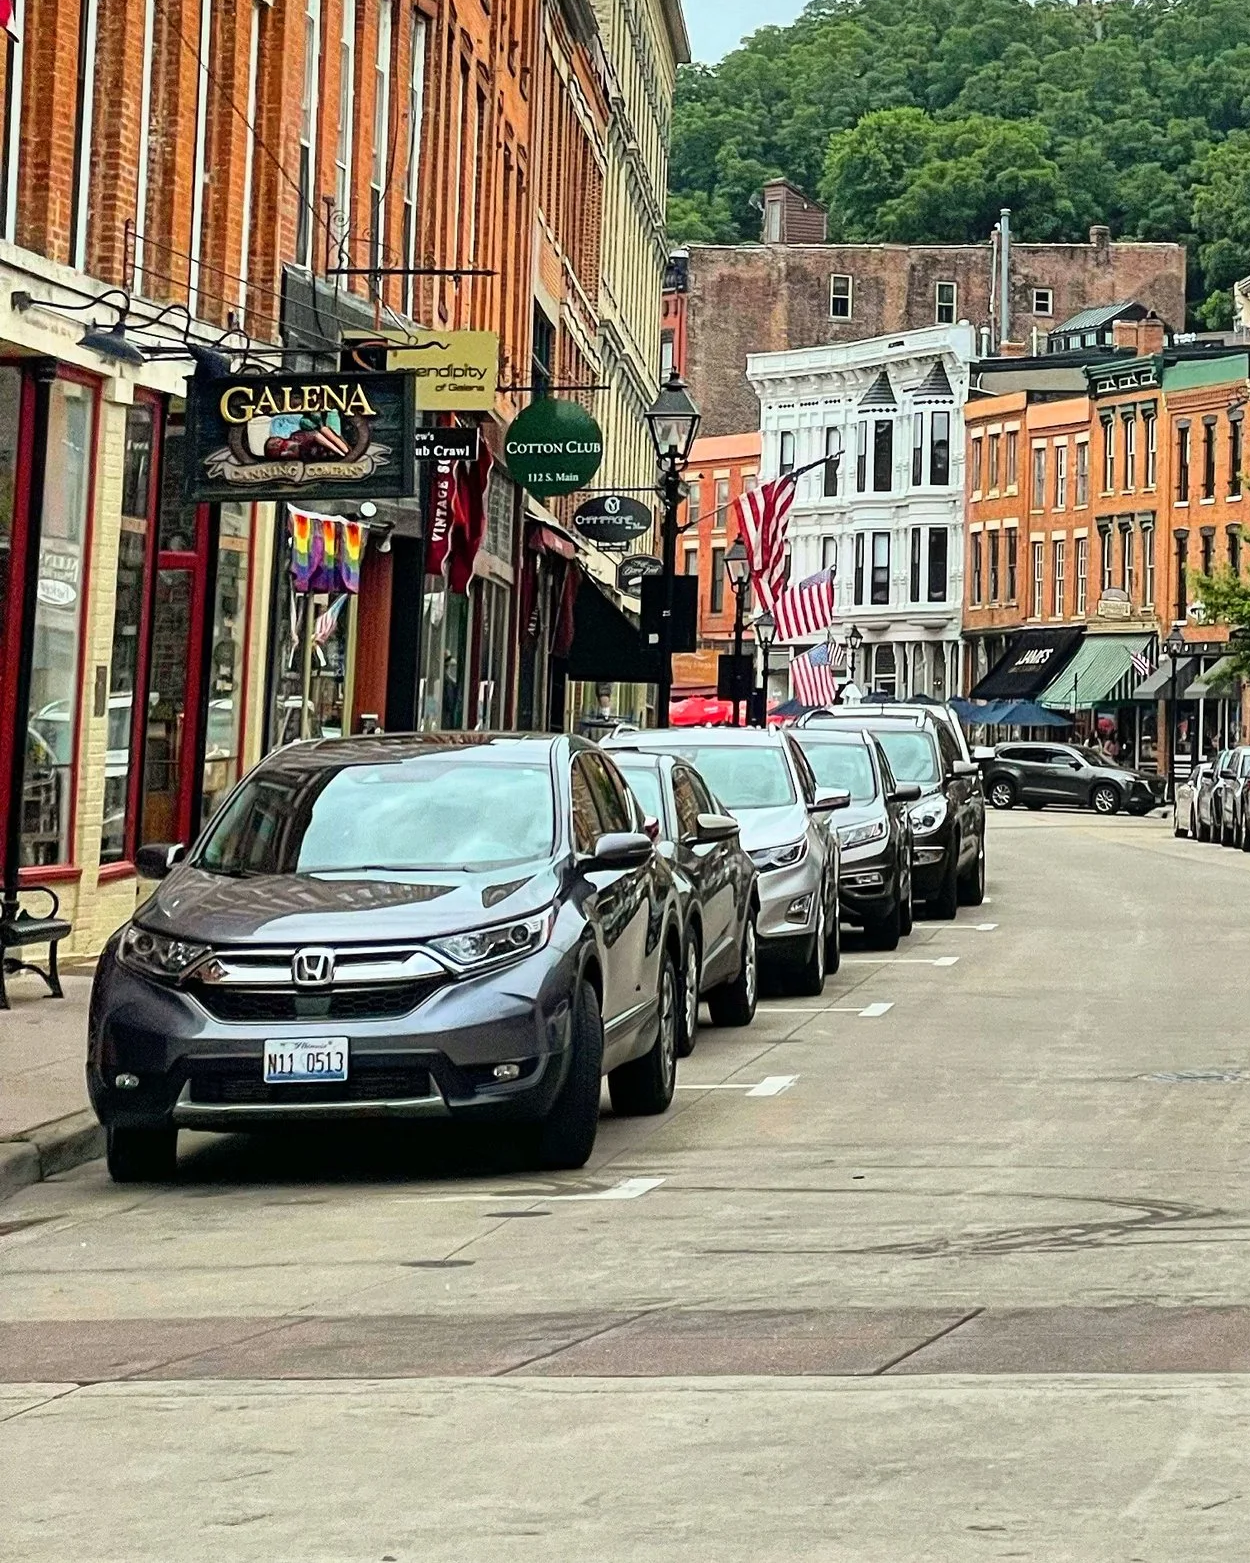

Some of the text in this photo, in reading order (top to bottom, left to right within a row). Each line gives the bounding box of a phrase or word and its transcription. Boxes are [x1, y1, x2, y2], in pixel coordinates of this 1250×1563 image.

[220, 383, 377, 424] GALENA
[415, 432, 435, 441] ew's
[415, 445, 470, 456] ub Crawl
[506, 441, 601, 454] COTTON CLUB
[231, 462, 367, 480] CANNING COMPANY
[528, 473, 543, 482] 112
[555, 473, 579, 482] Main
[431, 480, 449, 542] VINTAGE
[306, 1051, 344, 1073] 0513
